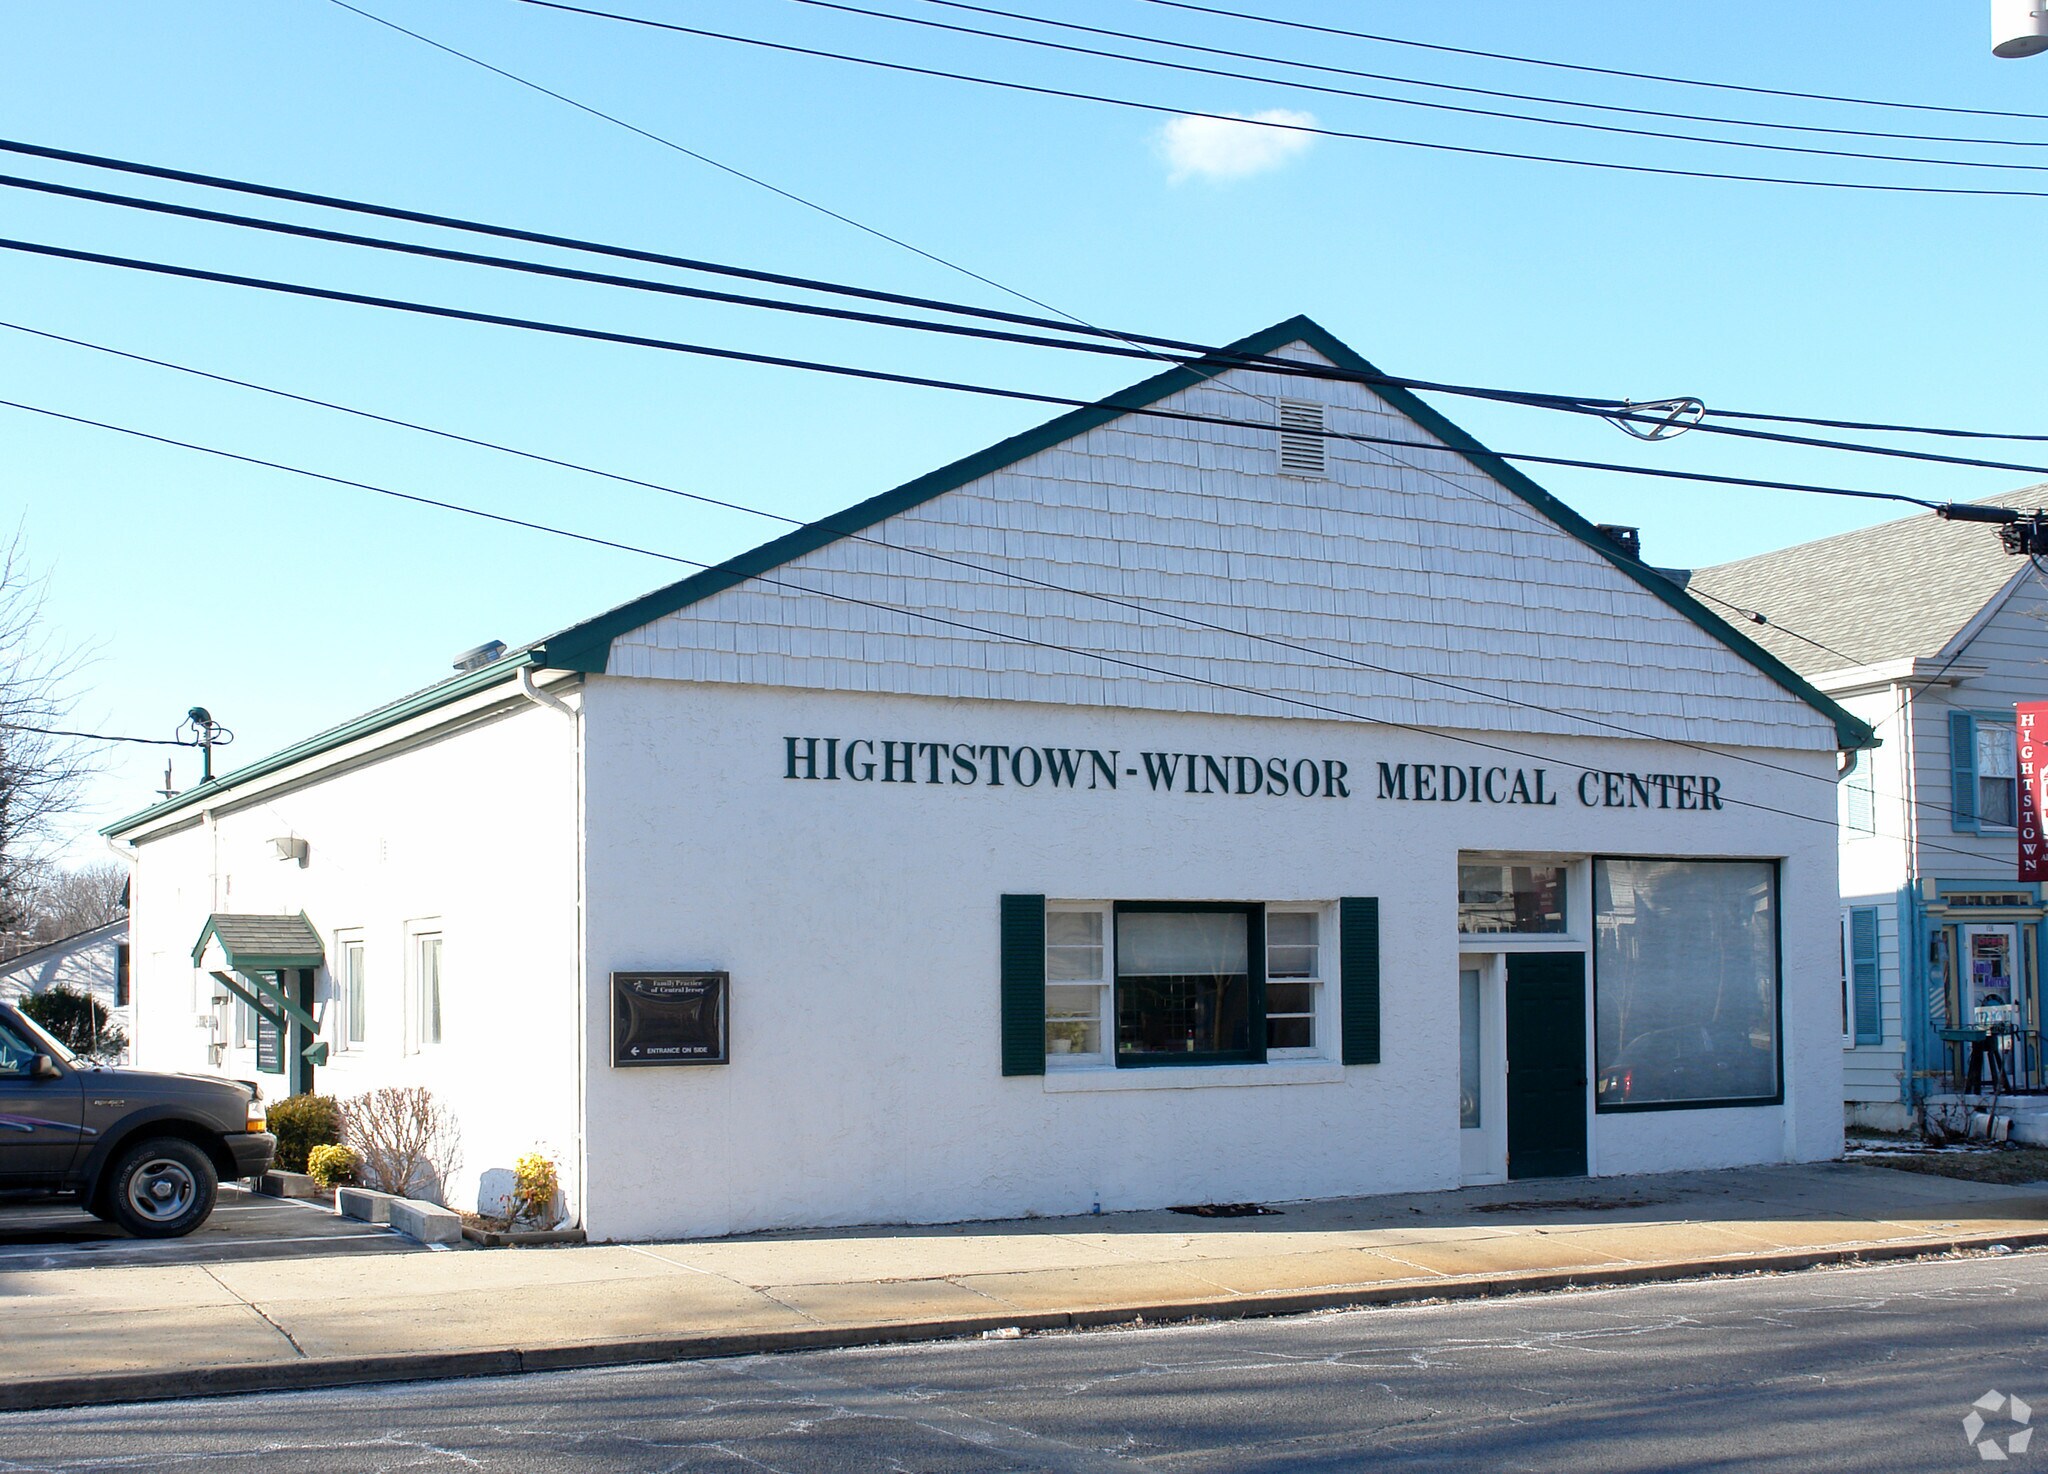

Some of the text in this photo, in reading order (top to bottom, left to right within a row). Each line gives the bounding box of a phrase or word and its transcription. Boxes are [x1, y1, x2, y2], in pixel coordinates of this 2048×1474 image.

[783, 736, 1724, 811] HIGHTSTOWN-WINDSOR MEDICAL CENTER
[2020, 714, 2037, 870] HIGHTSTOWN
